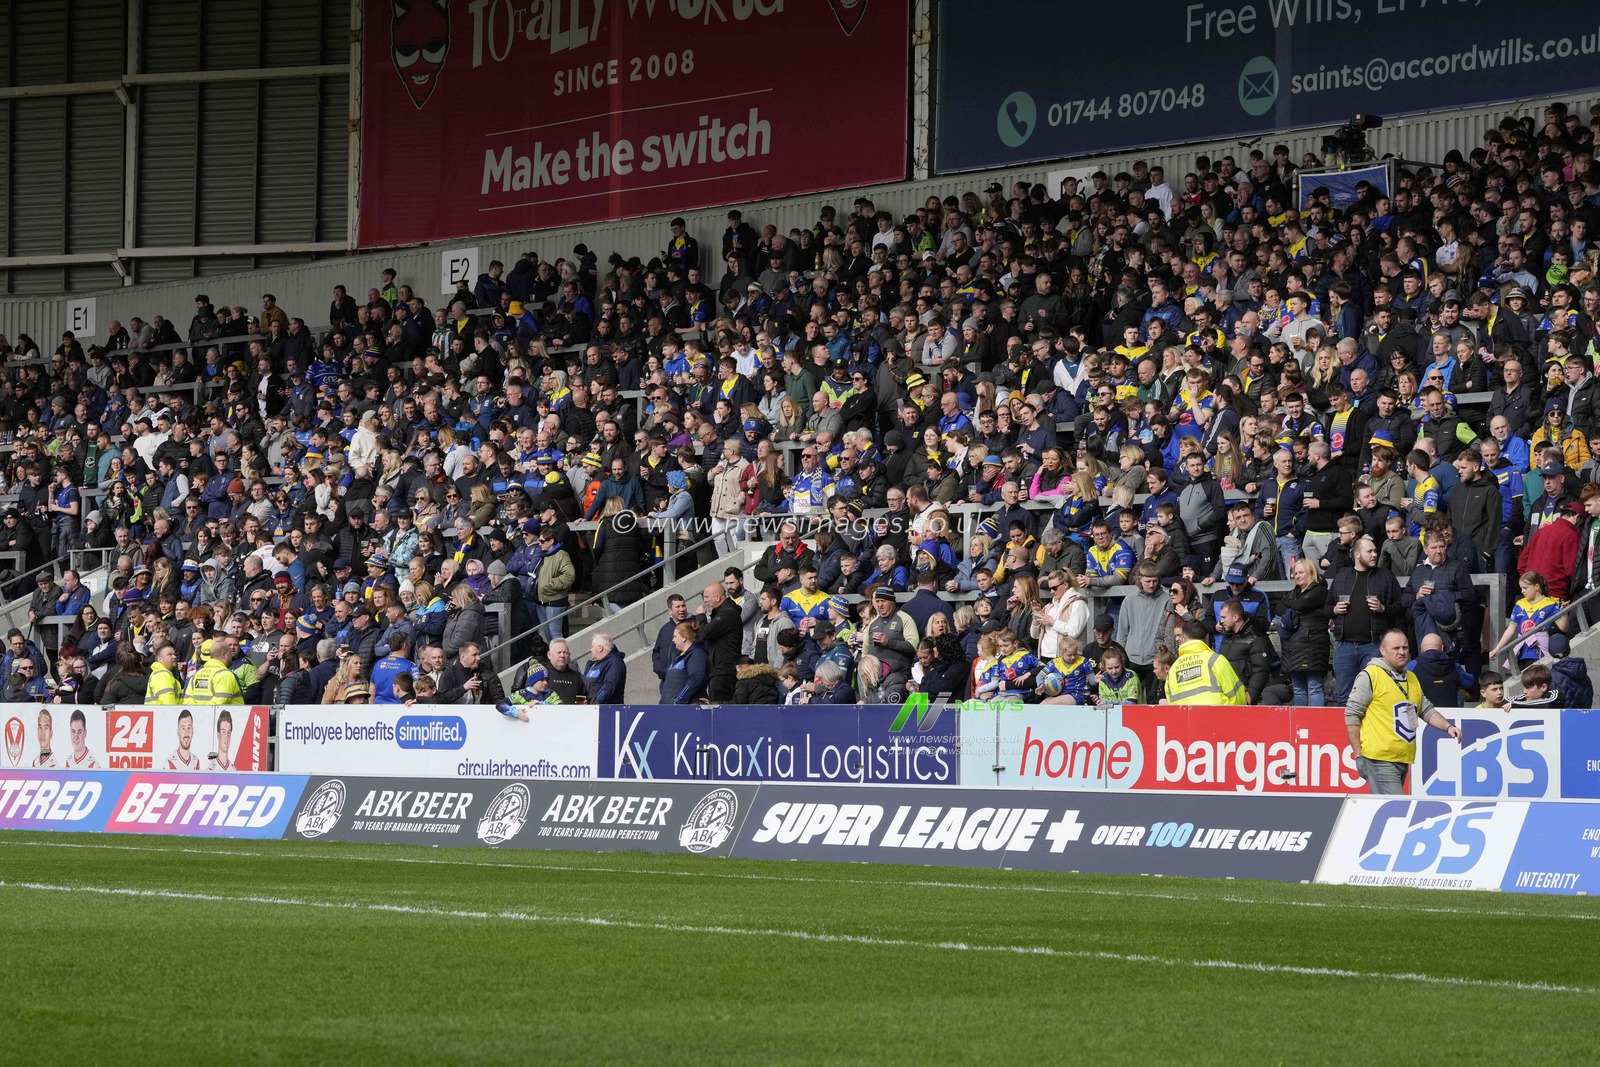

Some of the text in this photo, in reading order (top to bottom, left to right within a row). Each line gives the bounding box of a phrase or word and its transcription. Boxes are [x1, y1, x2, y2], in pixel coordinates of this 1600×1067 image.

[1186, 4, 1256, 43] Free
[553, 49, 694, 96] SINCE 2008
[1291, 28, 1600, 94] saints@accordwills.co.u
[1047, 83, 1205, 127] 01744 807048
[481, 107, 771, 195] Make the switch
[451, 258, 470, 284] E2
[73, 306, 88, 331] E1
[1175, 660, 1203, 670] STEWARD
[1178, 654, 1200, 664] SAFETY
[111, 715, 149, 748] 24
[285, 721, 463, 745] Employee benefits simplified.
[457, 758, 590, 778] circularbenefits.com
[673, 732, 949, 783] Kinaxia Logistics
[1019, 725, 1367, 792] home bargains
[1422, 718, 1549, 797] CBS
[0, 779, 102, 821] TFRED
[115, 782, 286, 828] BETFRED
[354, 790, 413, 817] ABK
[407, 791, 473, 819] BEER
[541, 794, 605, 823] ABK
[600, 796, 673, 825] BEER
[304, 817, 328, 830] ABK
[351, 821, 460, 833] 700 YEARS OF BAVARIAN PERFECTION
[486, 822, 511, 836] ABK
[538, 827, 660, 840] 700 YEARS OF BAVARIAN PERFECTION
[689, 830, 717, 844] ABK
[752, 802, 884, 846] SUPER
[1091, 822, 1312, 852] OVER 100 LIVE GAMES
[1358, 800, 1497, 874] CBS
[1348, 875, 1472, 888] CRITICAL BUSINESS SOLUTIONS LTD
[1515, 871, 1581, 889] INTEGRITY
